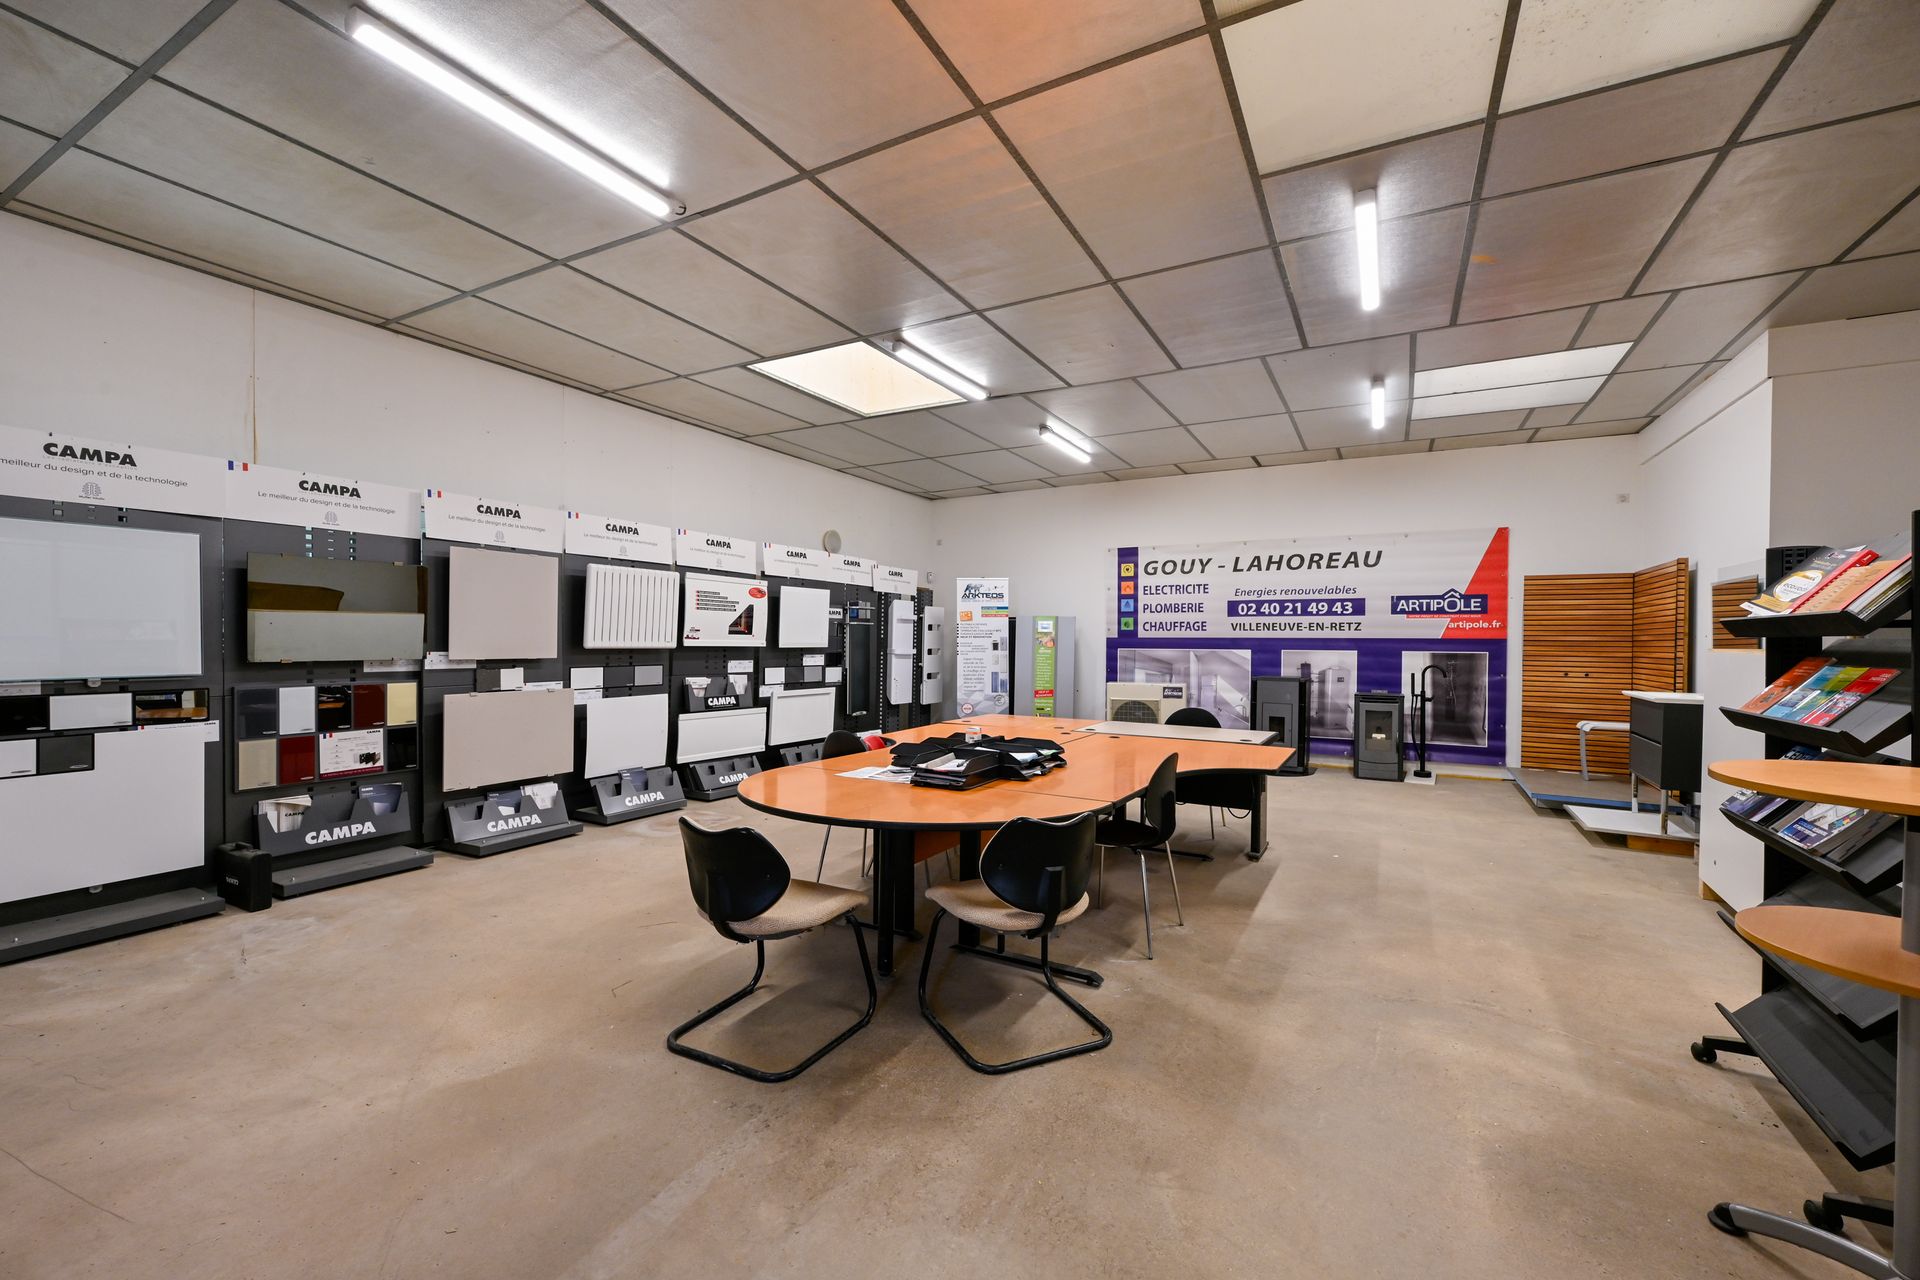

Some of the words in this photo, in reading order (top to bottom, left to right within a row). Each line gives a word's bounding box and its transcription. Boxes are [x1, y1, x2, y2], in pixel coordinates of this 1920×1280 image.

[43, 442, 137, 467] CAMPA
[0, 458, 41, 468] meilleur
[44, 463, 58, 471] du
[60, 465, 94, 476] design
[109, 471, 122, 479] de
[135, 475, 188, 487] technologie
[299, 480, 361, 499] CAMPA
[269, 492, 298, 501] meilleur
[310, 498, 333, 507] design
[360, 504, 396, 514] technologie
[476, 504, 521, 519] CAMPA
[605, 523, 639, 536] CAMPA
[706, 538, 731, 549] CAMPA
[787, 550, 807, 559] CAMPA
[843, 559, 861, 567] CAMPA
[1143, 558, 1213, 576] GOUY
[1232, 550, 1383, 573] LAHOREAU
[888, 570, 903, 578] CAMPA
[1143, 583, 1209, 595] ELECTRICITE
[1234, 587, 1277, 598] Energies
[1280, 585, 1357, 596] renouvelables
[1143, 603, 1204, 613] PLOMBERIE
[1238, 603, 1257, 615] 02
[1260, 602, 1279, 615] 40
[1284, 603, 1301, 615] 21
[1307, 602, 1328, 614] 49
[1332, 602, 1353, 614] 43
[1142, 621, 1207, 631] CHAUFFAGE
[1231, 622, 1362, 631] VILLENEUVE-EN-RETZ
[1448, 620, 1501, 630] artipole.fr
[708, 696, 736, 706] CAMPA
[719, 772, 749, 784] CAMPA
[624, 791, 665, 807] CAMPA
[487, 814, 542, 832] CAMPA
[305, 821, 376, 845] CAMPA
